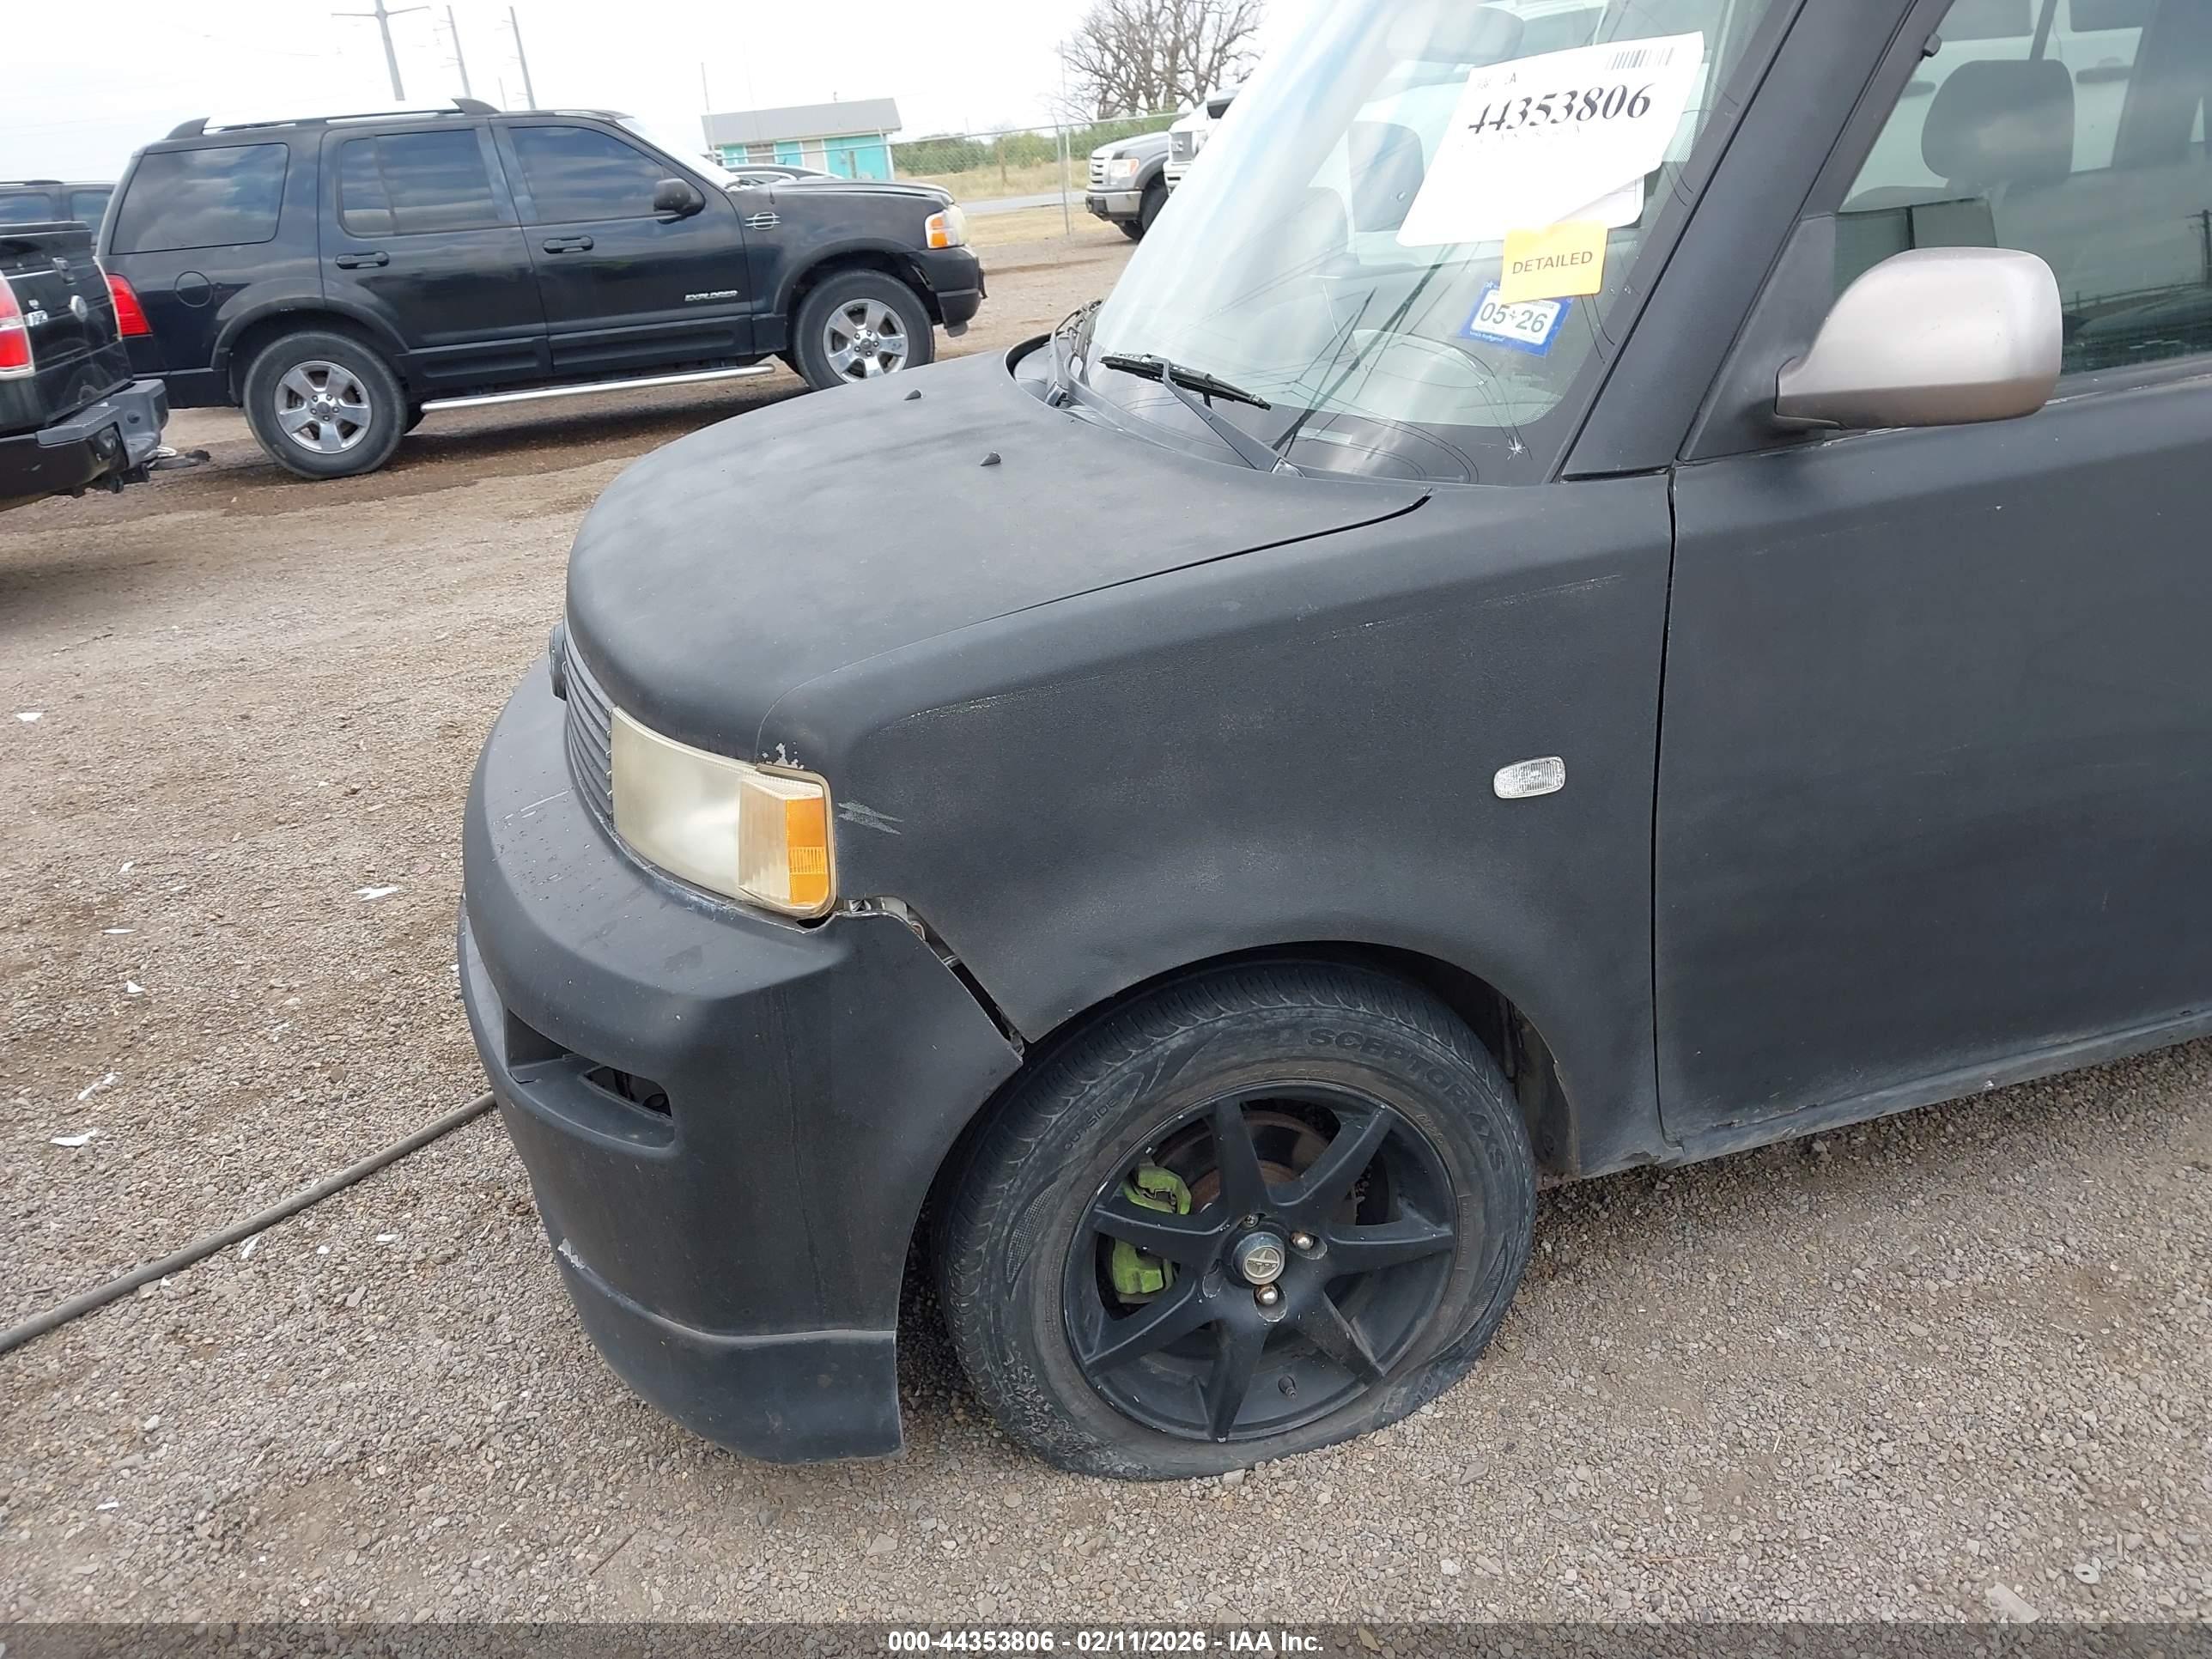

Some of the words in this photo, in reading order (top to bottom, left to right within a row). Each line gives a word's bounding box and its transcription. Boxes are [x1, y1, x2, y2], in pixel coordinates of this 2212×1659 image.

[1468, 82, 1656, 135] 44353806
[1511, 251, 1594, 275] DETAILED
[1480, 301, 1510, 325] 05
[1515, 309, 1548, 333] 26
